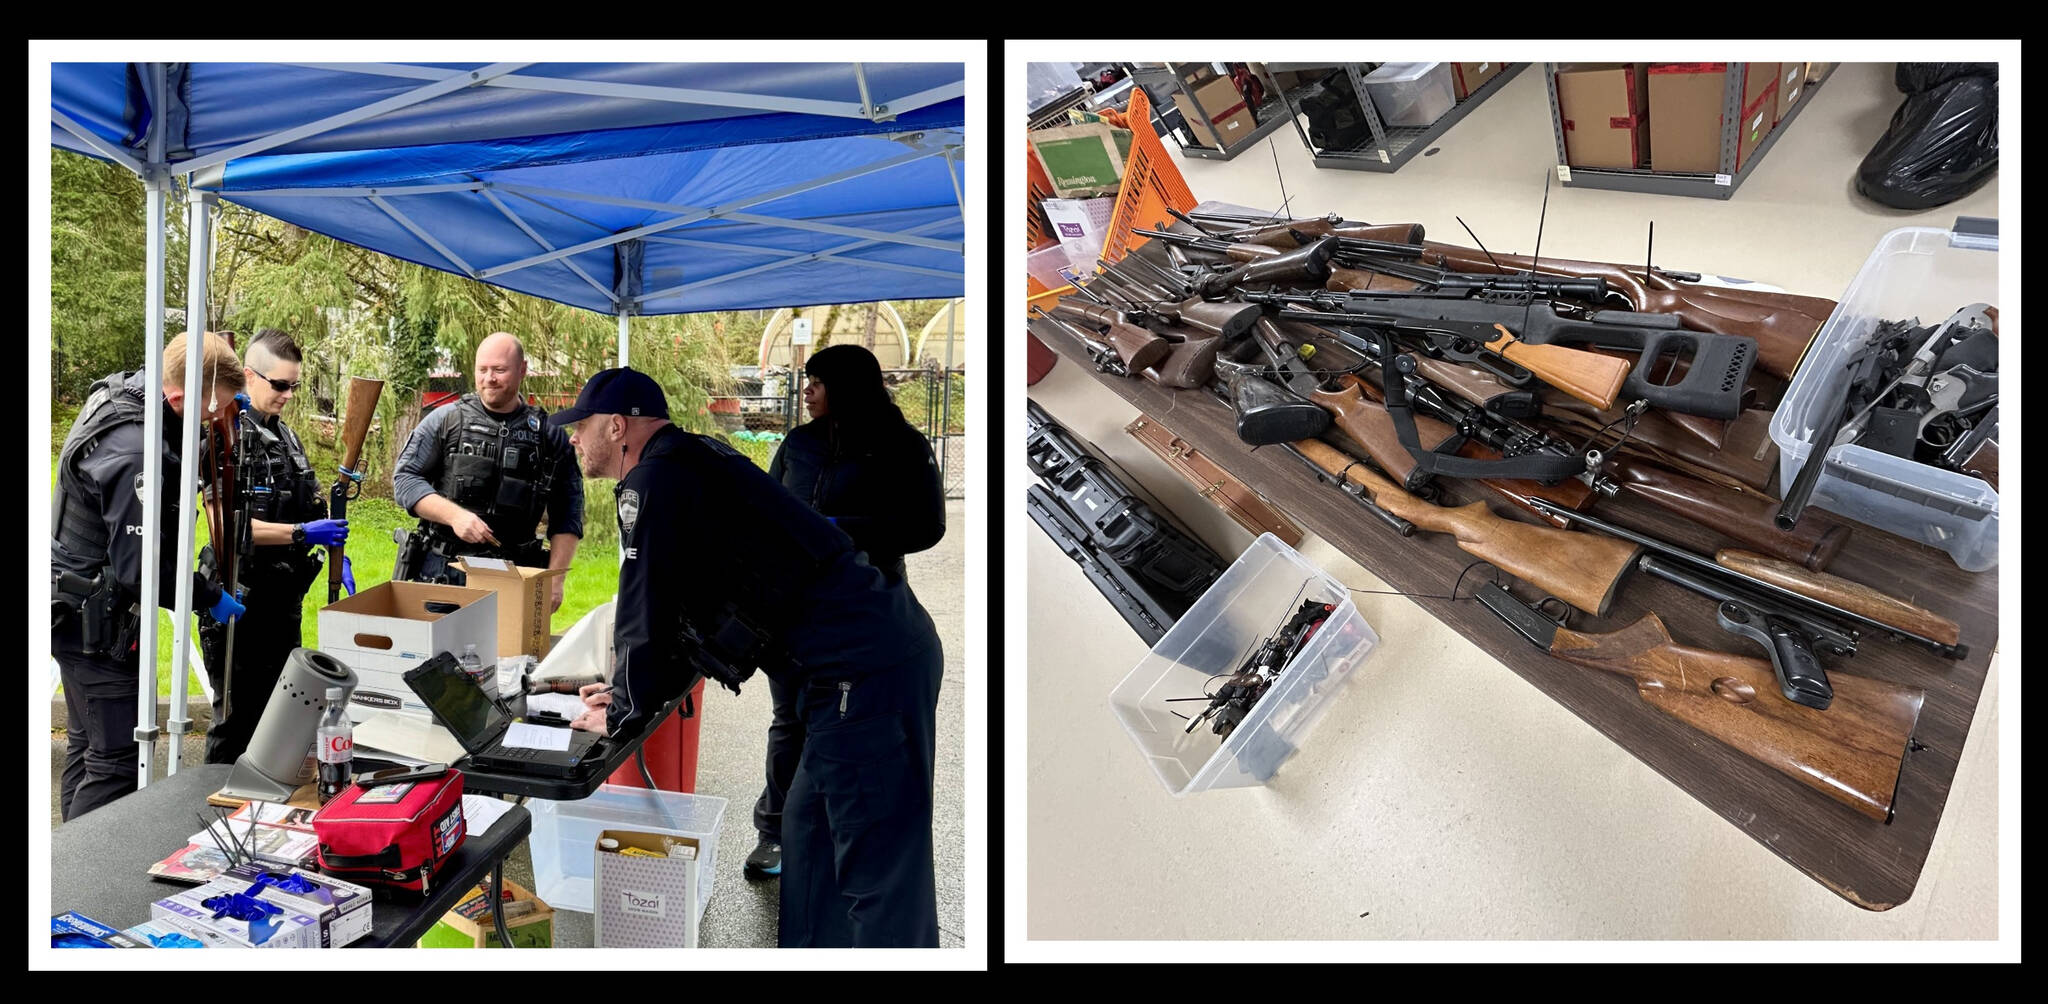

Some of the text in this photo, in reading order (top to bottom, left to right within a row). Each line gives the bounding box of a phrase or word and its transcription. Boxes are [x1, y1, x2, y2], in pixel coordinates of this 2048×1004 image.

[1057, 176, 1097, 188] Remington
[512, 429, 540, 444] POLICE
[351, 693, 399, 706] BANKERS BOX
[622, 892, 659, 909] Tozai
